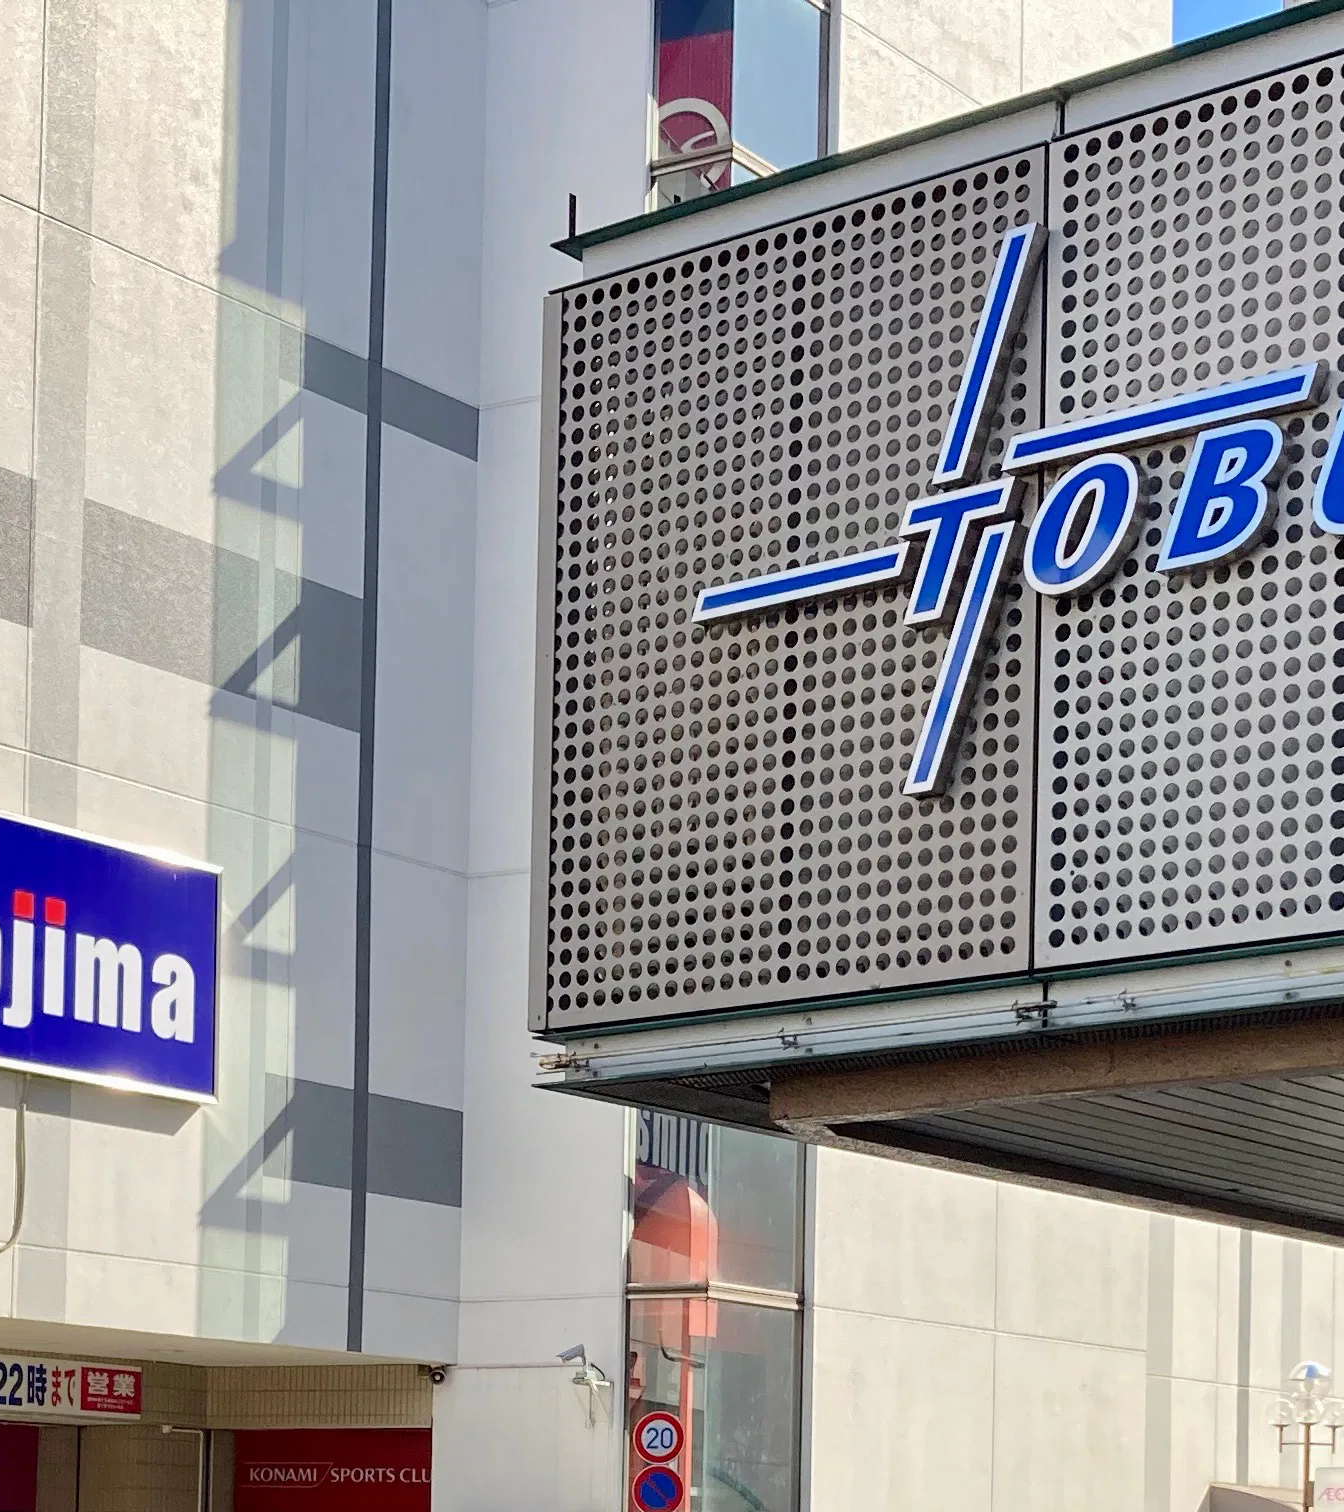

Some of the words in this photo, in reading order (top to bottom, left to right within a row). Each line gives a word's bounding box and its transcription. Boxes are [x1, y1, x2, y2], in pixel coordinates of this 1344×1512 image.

[87, 1370, 136, 1398] 営業
[645, 1427, 674, 1450] 20
[249, 1467, 317, 1483] KONAMI
[330, 1467, 395, 1484] SPORTS
